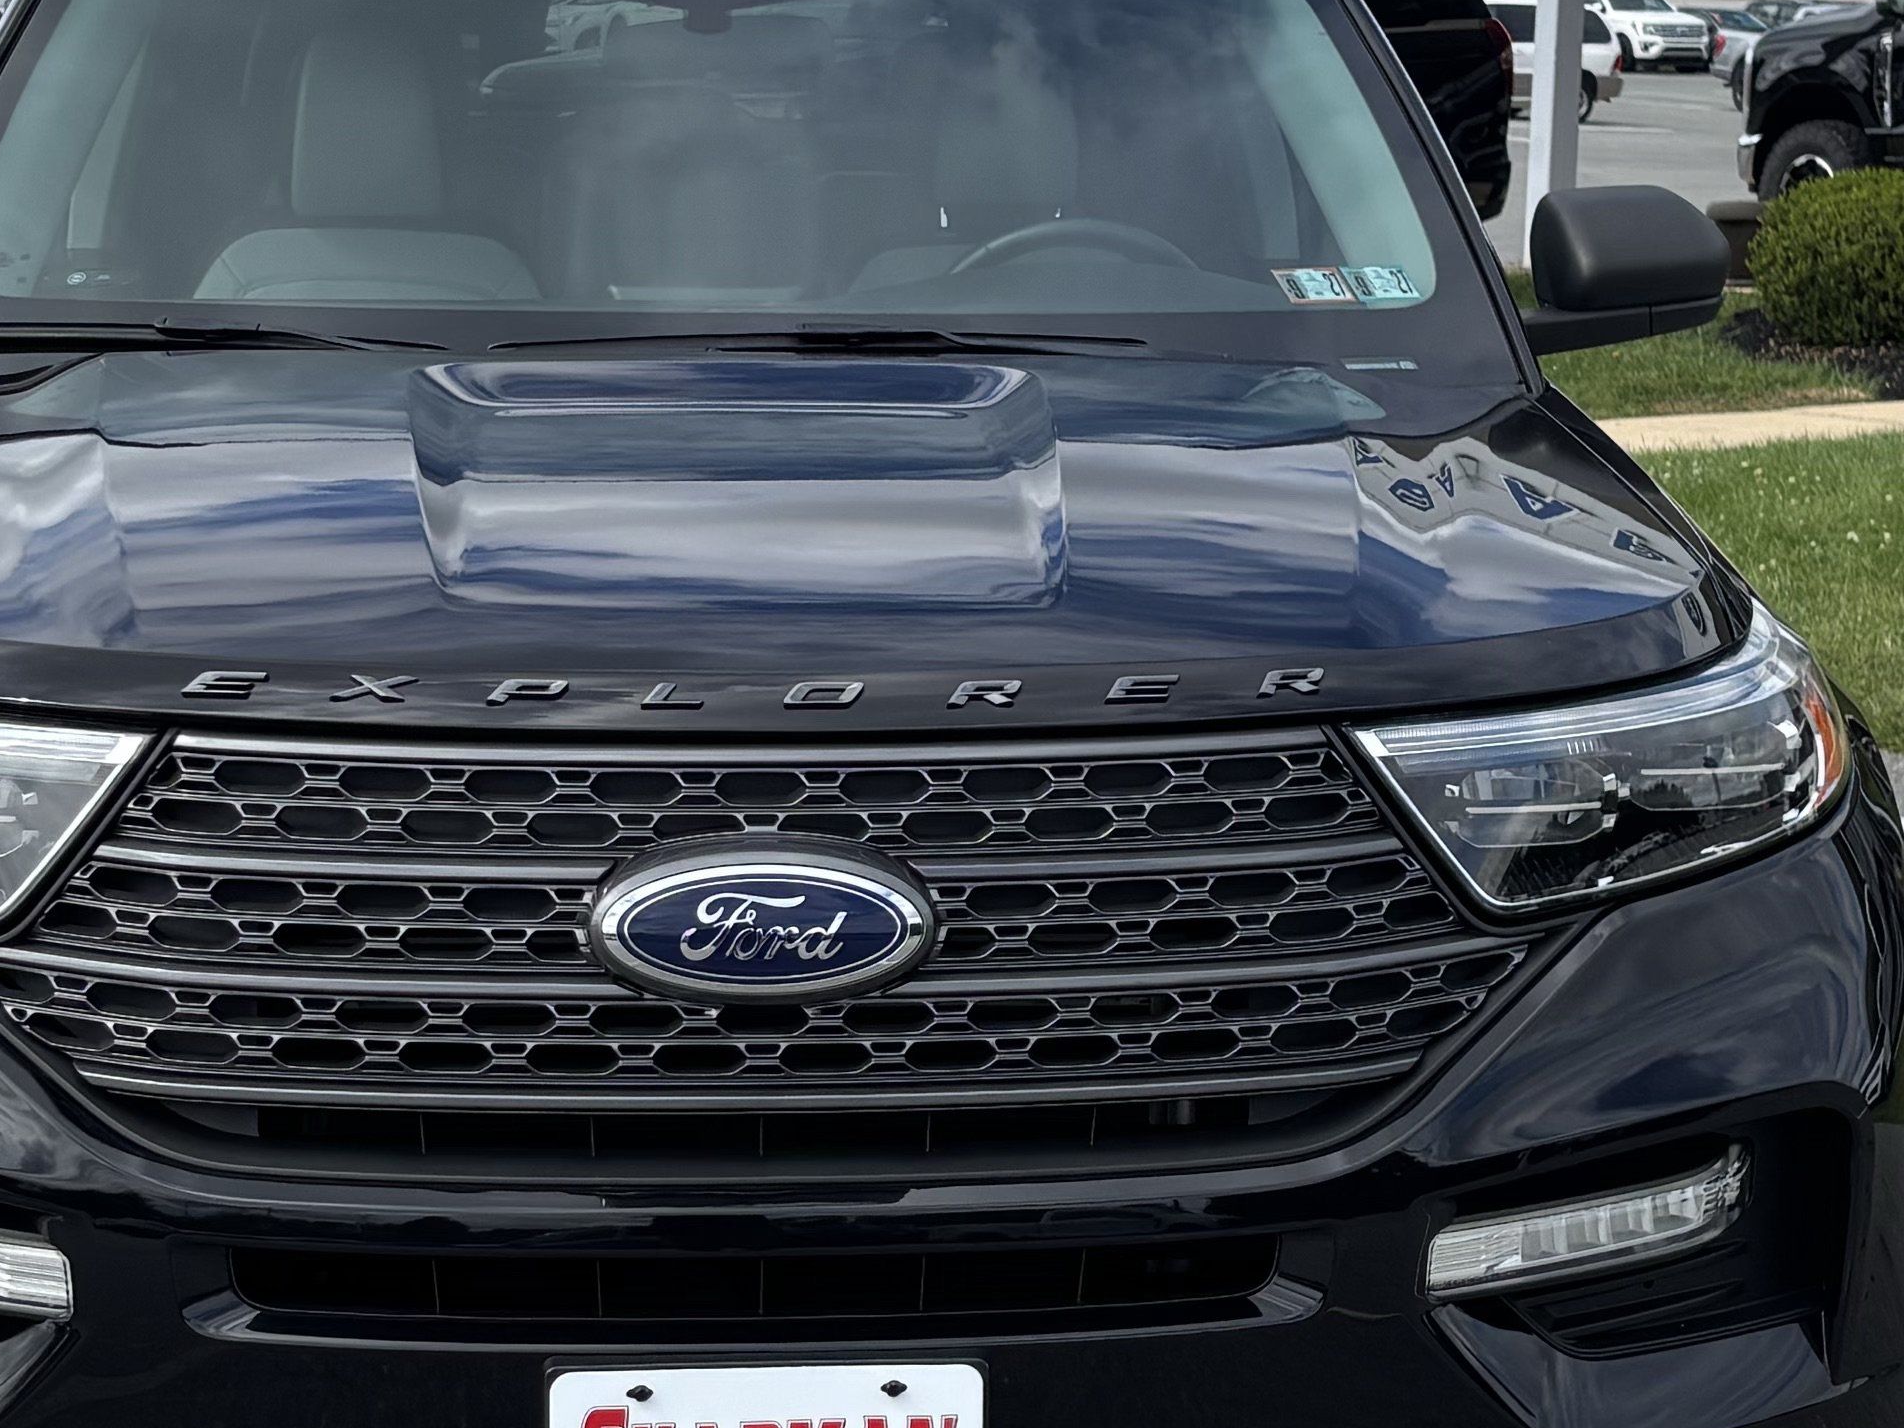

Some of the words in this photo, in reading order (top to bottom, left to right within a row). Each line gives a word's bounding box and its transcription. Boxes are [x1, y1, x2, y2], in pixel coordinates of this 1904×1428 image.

[1322, 272, 1346, 297] 27
[1389, 270, 1413, 294] 27
[180, 666, 1325, 711] EXPLORER
[680, 892, 848, 961] Ford
